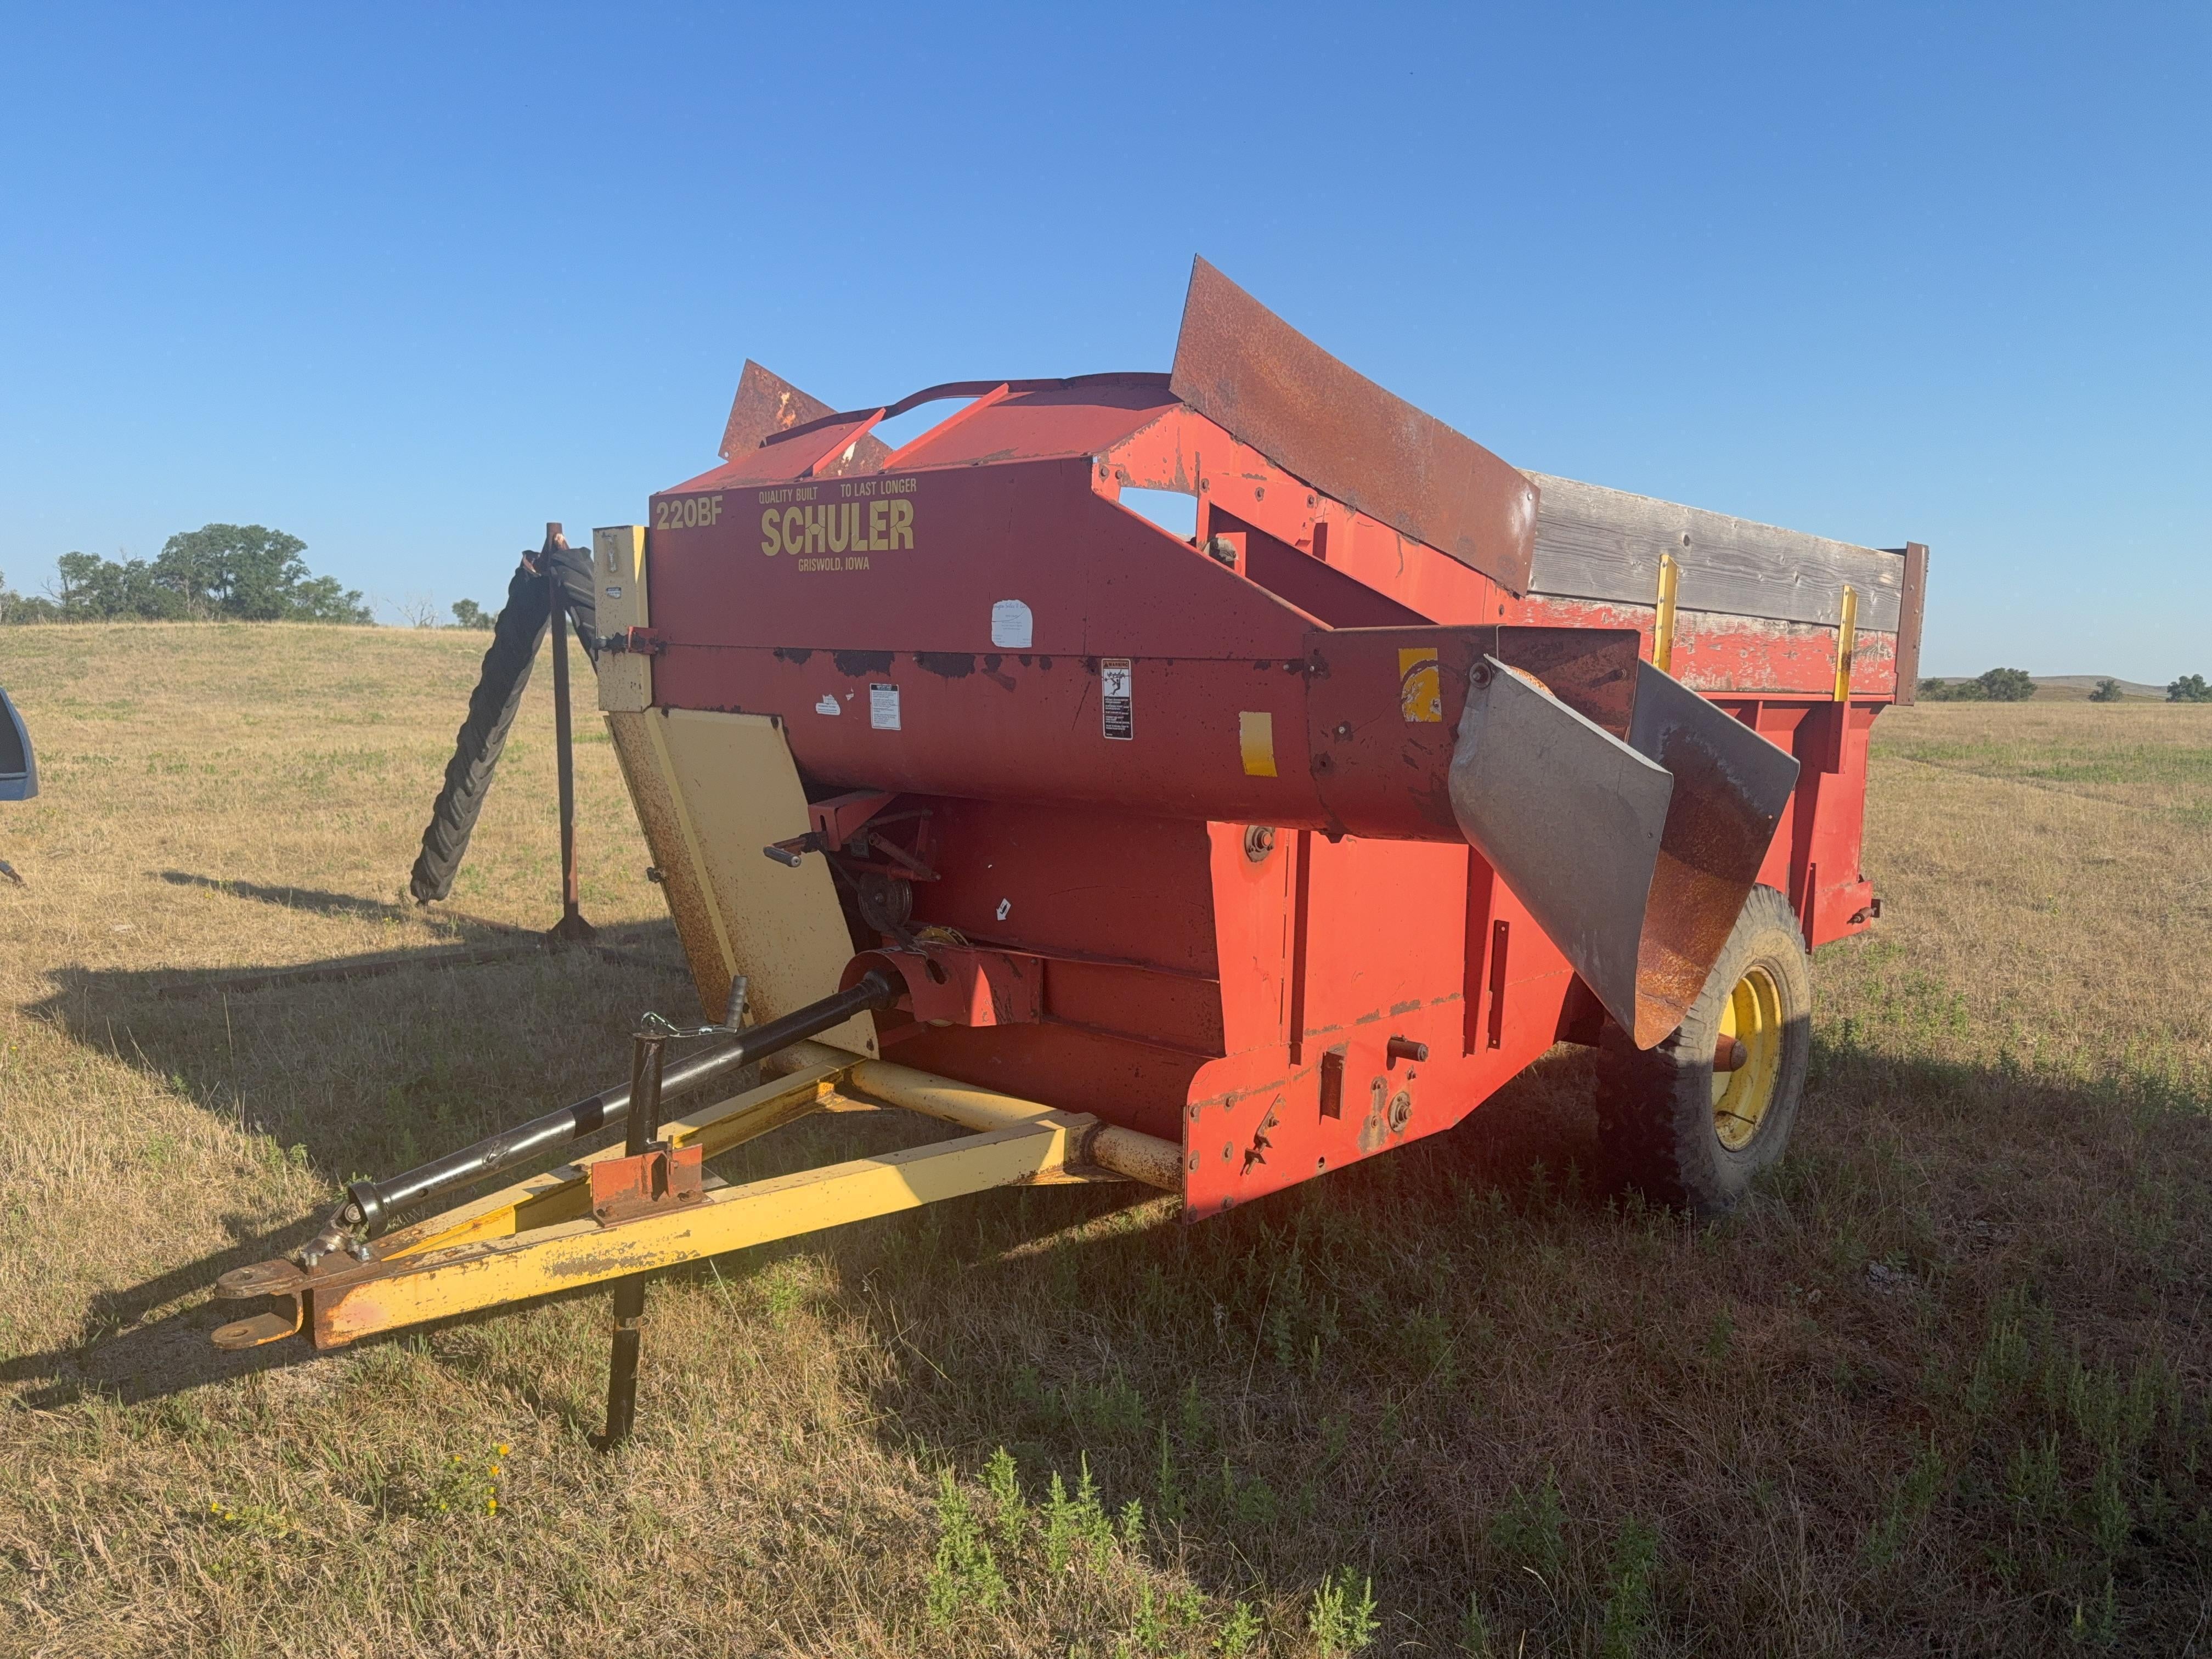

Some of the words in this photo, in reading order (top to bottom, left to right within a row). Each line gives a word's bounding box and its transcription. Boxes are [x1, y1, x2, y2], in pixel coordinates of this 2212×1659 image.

[759, 489, 793, 504] QUALITY
[796, 487, 818, 501] BUILT
[840, 484, 851, 498] TO
[854, 482, 876, 496] LAST
[881, 478, 917, 494] LONGER
[656, 495, 723, 530] 220BF
[761, 499, 914, 556] SCHULER
[798, 557, 843, 572] GRISWOLD,
[845, 556, 870, 570] IOWA
